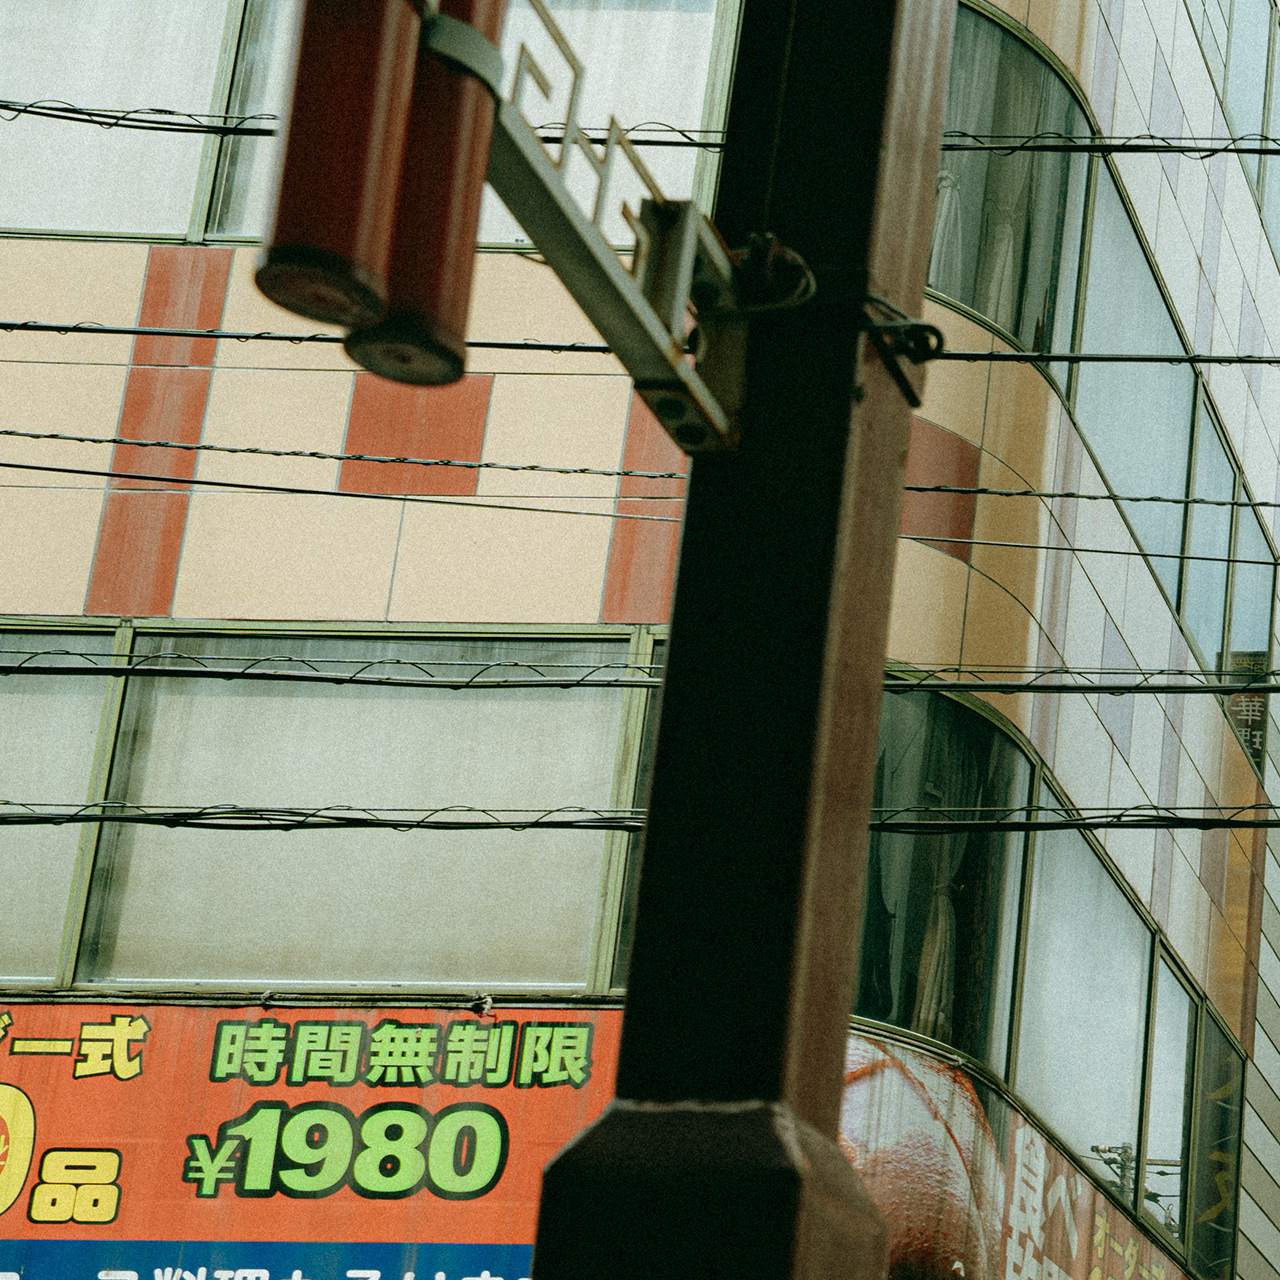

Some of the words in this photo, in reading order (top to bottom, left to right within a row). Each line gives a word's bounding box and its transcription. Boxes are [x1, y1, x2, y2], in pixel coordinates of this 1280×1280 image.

[212, 1021, 594, 1086] 時間無制限
[184, 1102, 508, 1198] ¥1980
